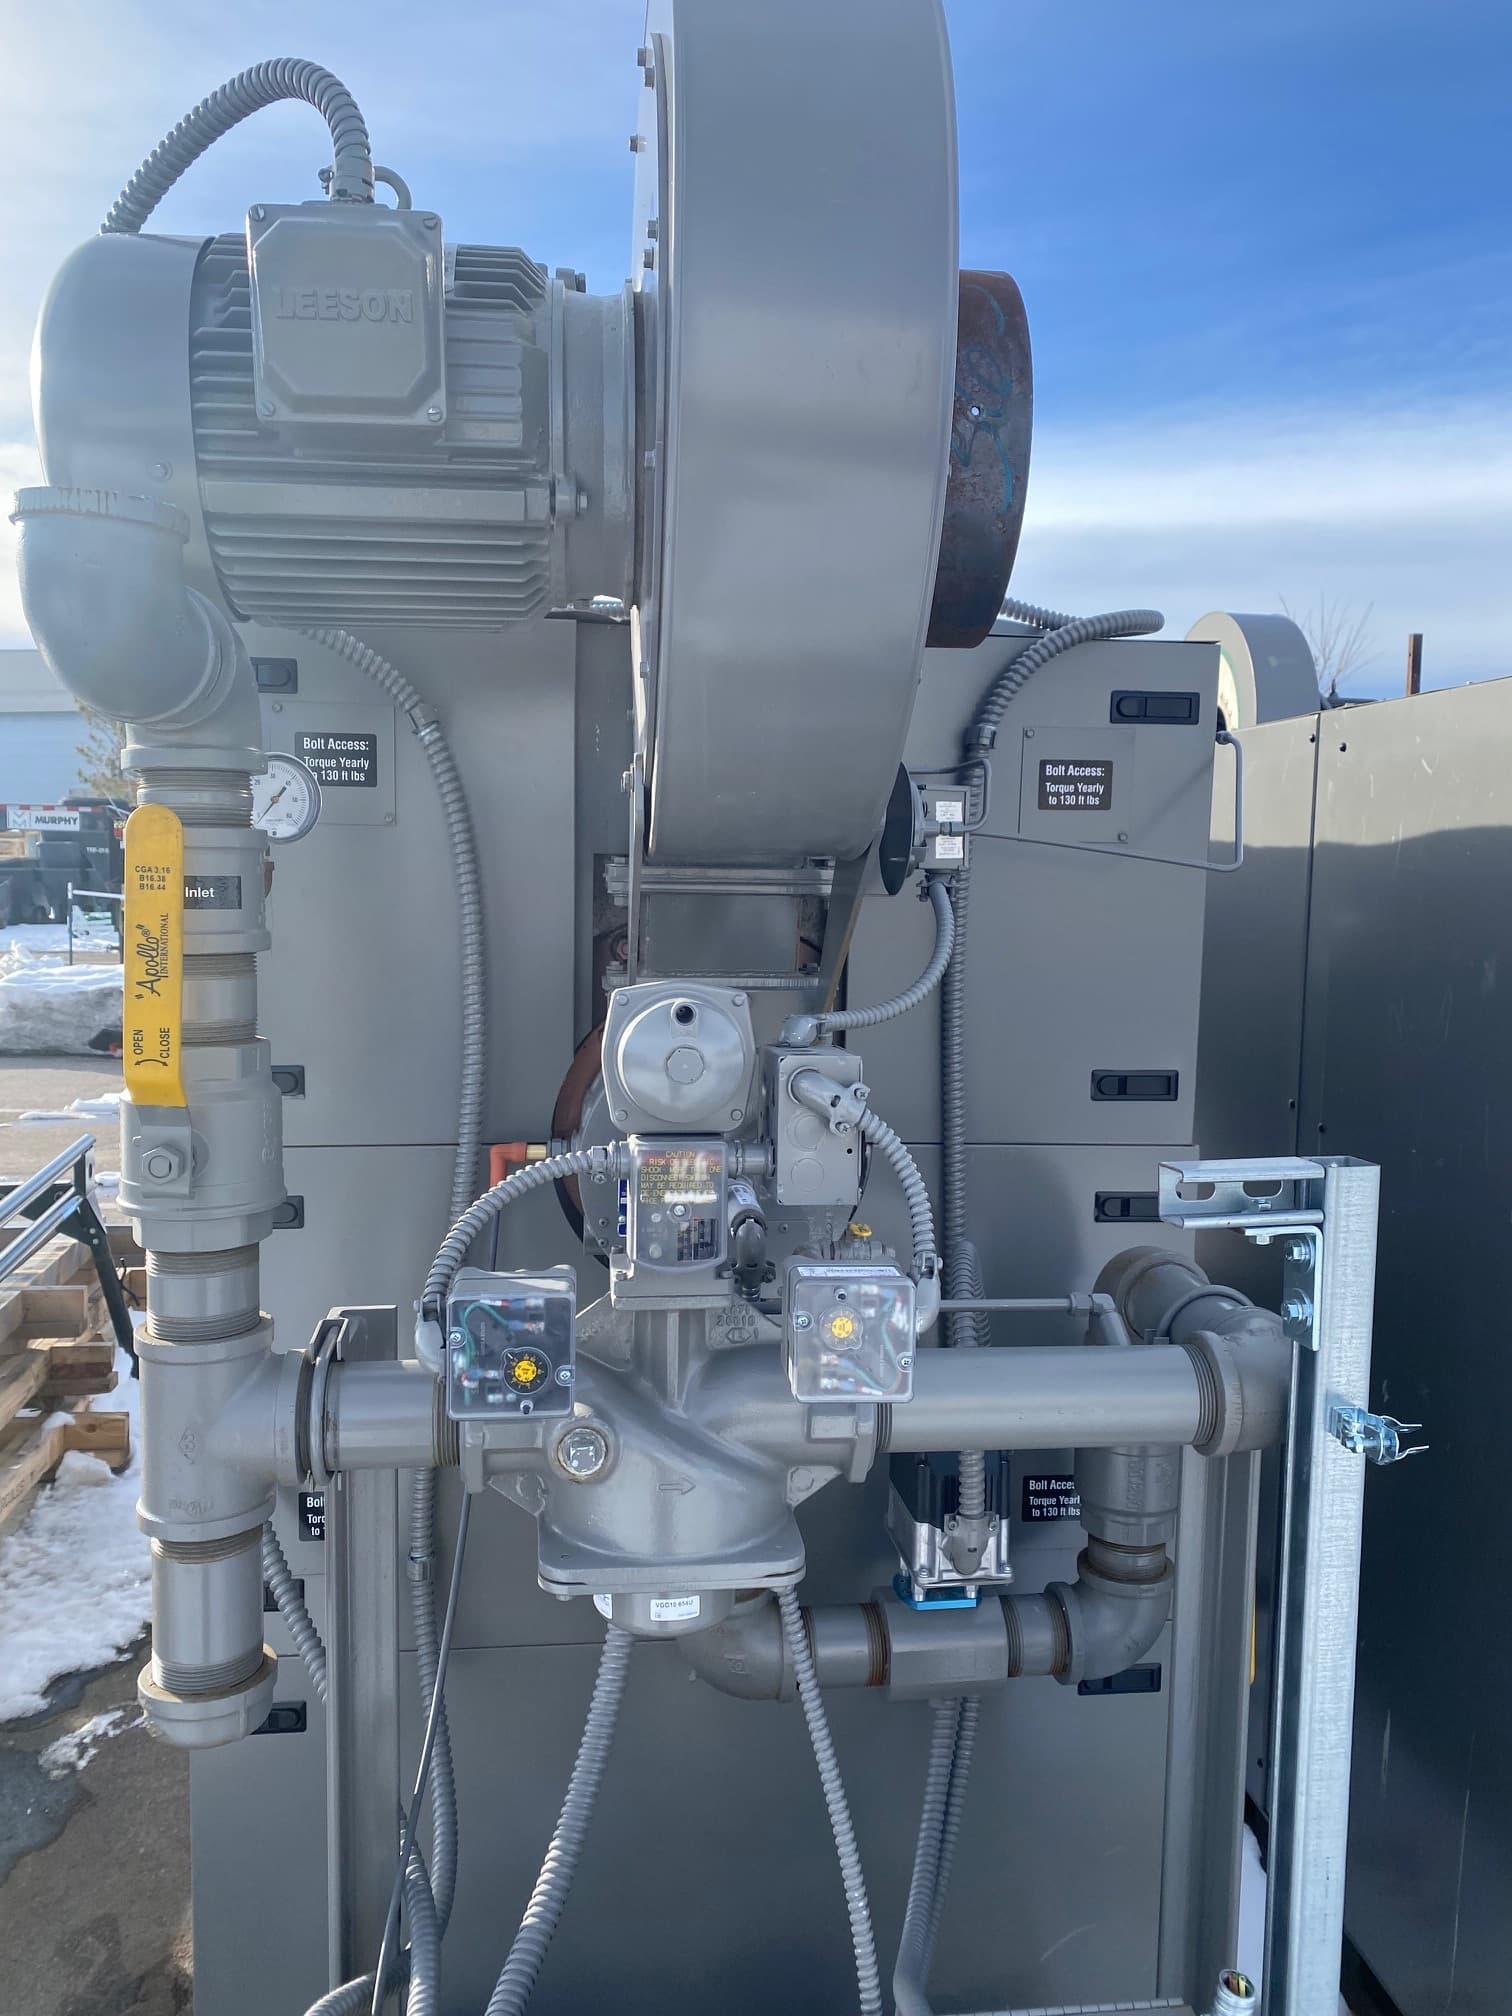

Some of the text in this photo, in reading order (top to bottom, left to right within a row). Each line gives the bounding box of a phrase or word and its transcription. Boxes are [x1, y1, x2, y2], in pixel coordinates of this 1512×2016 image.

[275, 288, 414, 323] LEESON
[303, 737, 369, 751] Bolt Access:
[303, 756, 370, 770] Torque Yearly
[321, 770, 339, 781] 130
[341, 770, 349, 781] ft
[351, 770, 366, 781] lbs
[1045, 764, 1105, 777] Bolt Access:
[1045, 782, 1104, 795] Torque Yearly
[1048, 795, 1100, 805] to 130 ft lbs
[34, 815, 78, 826] MURPHY
[134, 865, 153, 873] CGA
[139, 882, 166, 890] B16.44
[184, 886, 215, 898] Inlet
[160, 912, 169, 975] INTERNATIONAL
[133, 1029, 144, 1056] OPEN
[159, 1027, 170, 1059] CLOSE
[1029, 1479, 1048, 1490] Bolt
[1029, 1494, 1081, 1507] Torque Yearl
[1032, 1506, 1081, 1517] to 130 ft lbs
[311, 1526, 320, 1536] to
